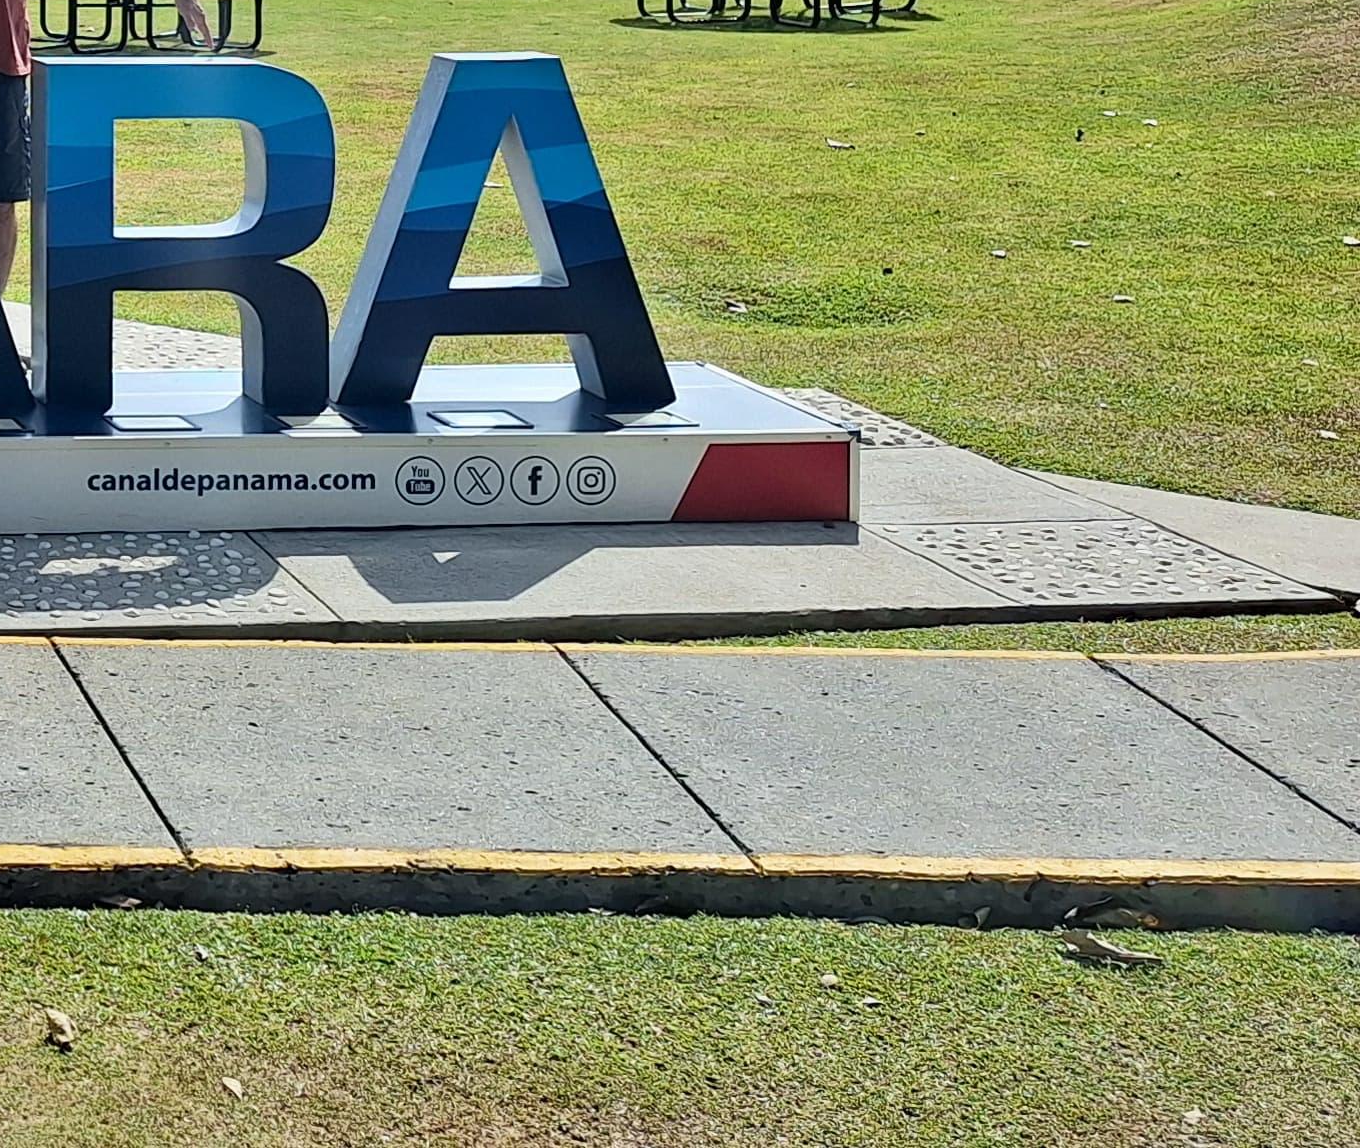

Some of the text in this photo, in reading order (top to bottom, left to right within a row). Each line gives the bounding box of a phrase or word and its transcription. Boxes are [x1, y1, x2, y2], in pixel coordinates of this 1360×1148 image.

[411, 465, 430, 478] You
[87, 467, 377, 495] canaldepanama.com
[409, 480, 432, 493] Tube
